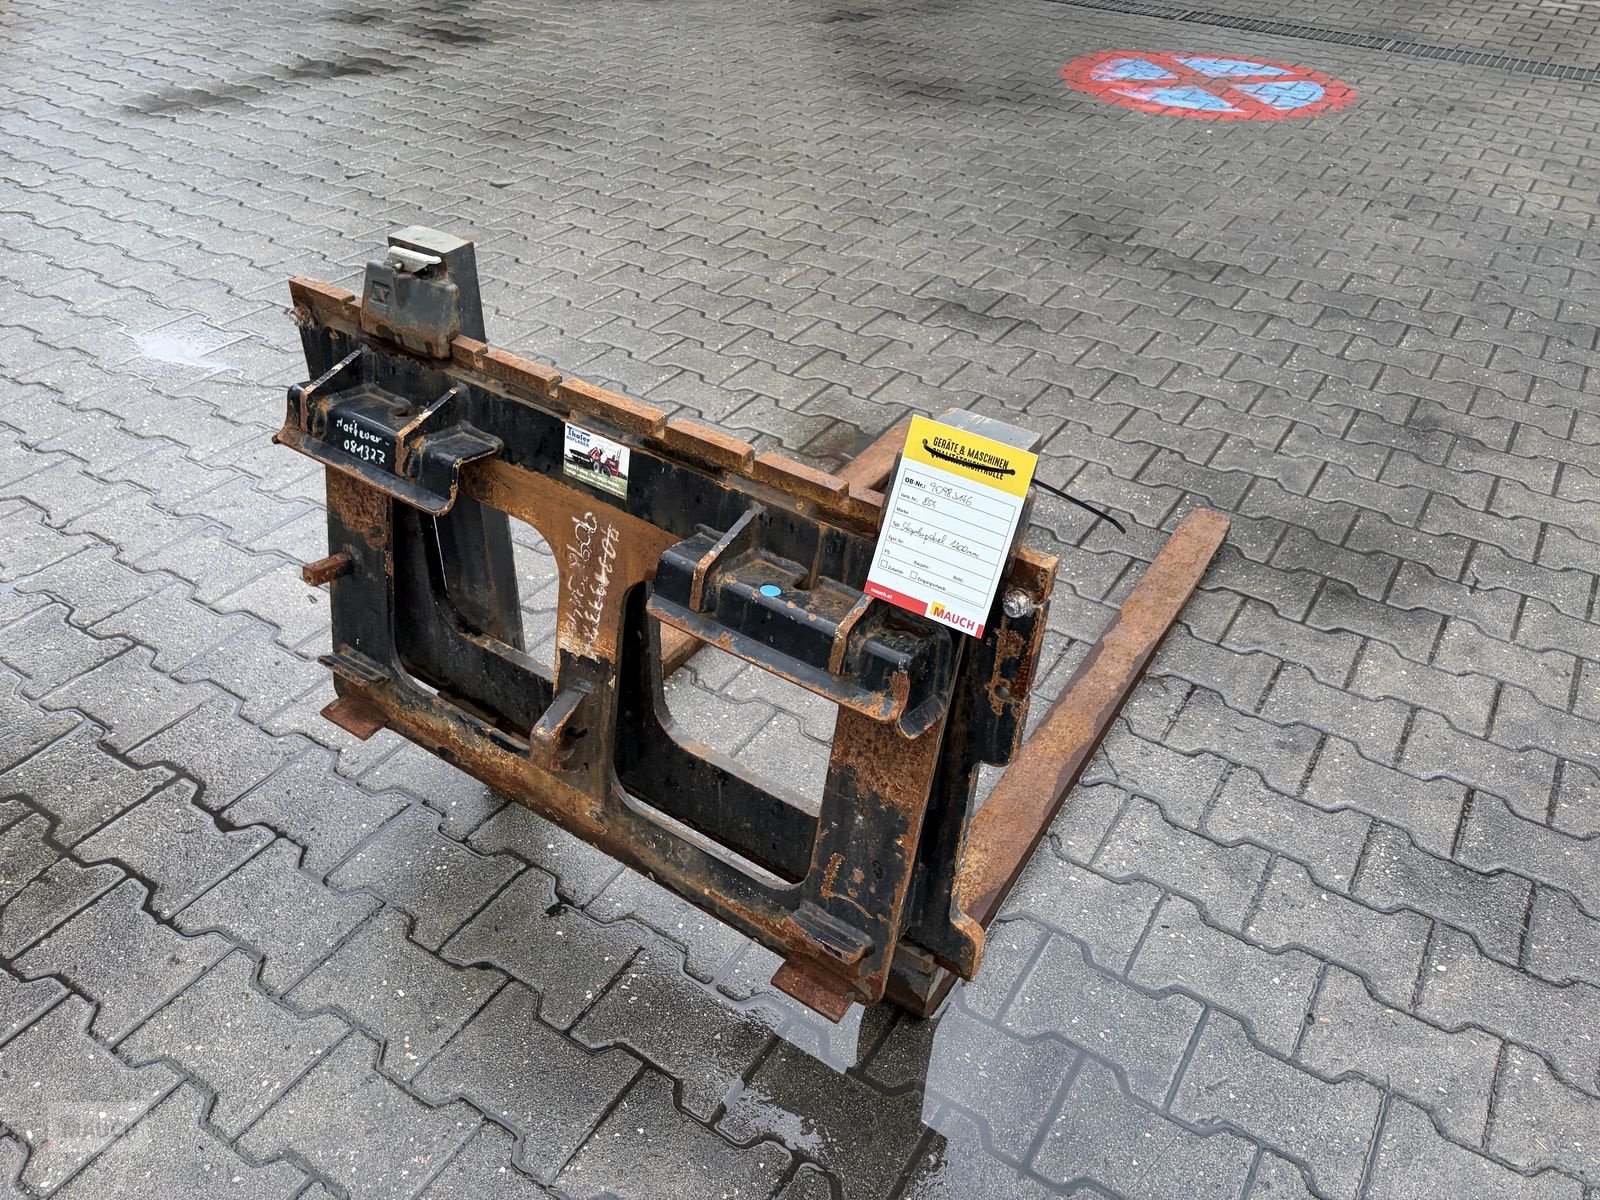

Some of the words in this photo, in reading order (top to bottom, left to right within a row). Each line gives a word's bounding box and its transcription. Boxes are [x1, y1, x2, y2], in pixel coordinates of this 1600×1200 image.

[566, 425, 590, 443] Thaler
[343, 440, 386, 463] 081327
[933, 436, 958, 452] GERÄTE
[959, 445, 966, 455] &
[967, 448, 1009, 469] MASCHINEN
[870, 586, 892, 599] mauch.at
[933, 606, 975, 631] MAUCH
